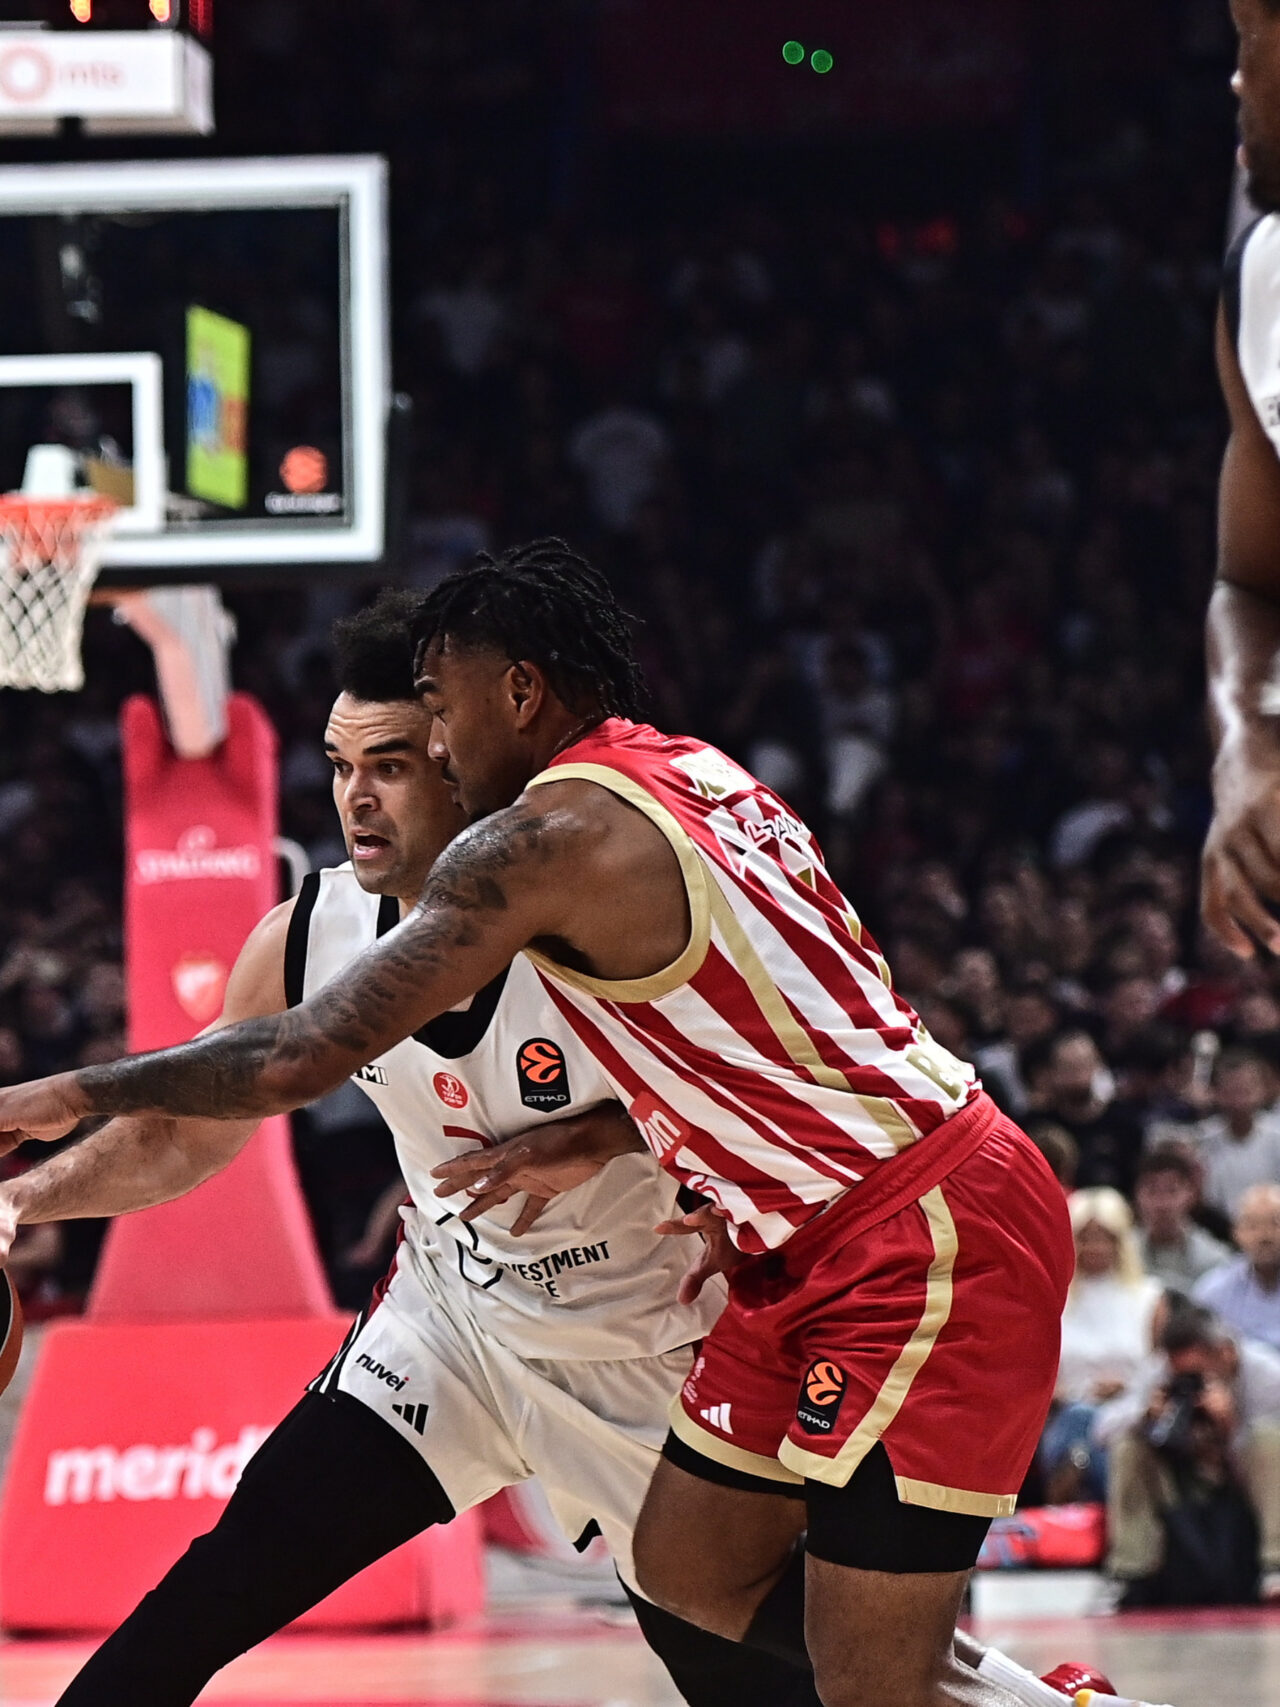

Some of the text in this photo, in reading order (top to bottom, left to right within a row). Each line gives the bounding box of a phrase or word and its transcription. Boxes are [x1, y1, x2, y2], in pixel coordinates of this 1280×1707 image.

[524, 1094, 566, 1103] ETIHAD
[356, 1353, 410, 1393] nuvei
[798, 1410, 831, 1430] ETIHAD
[45, 1423, 279, 1506] merid
